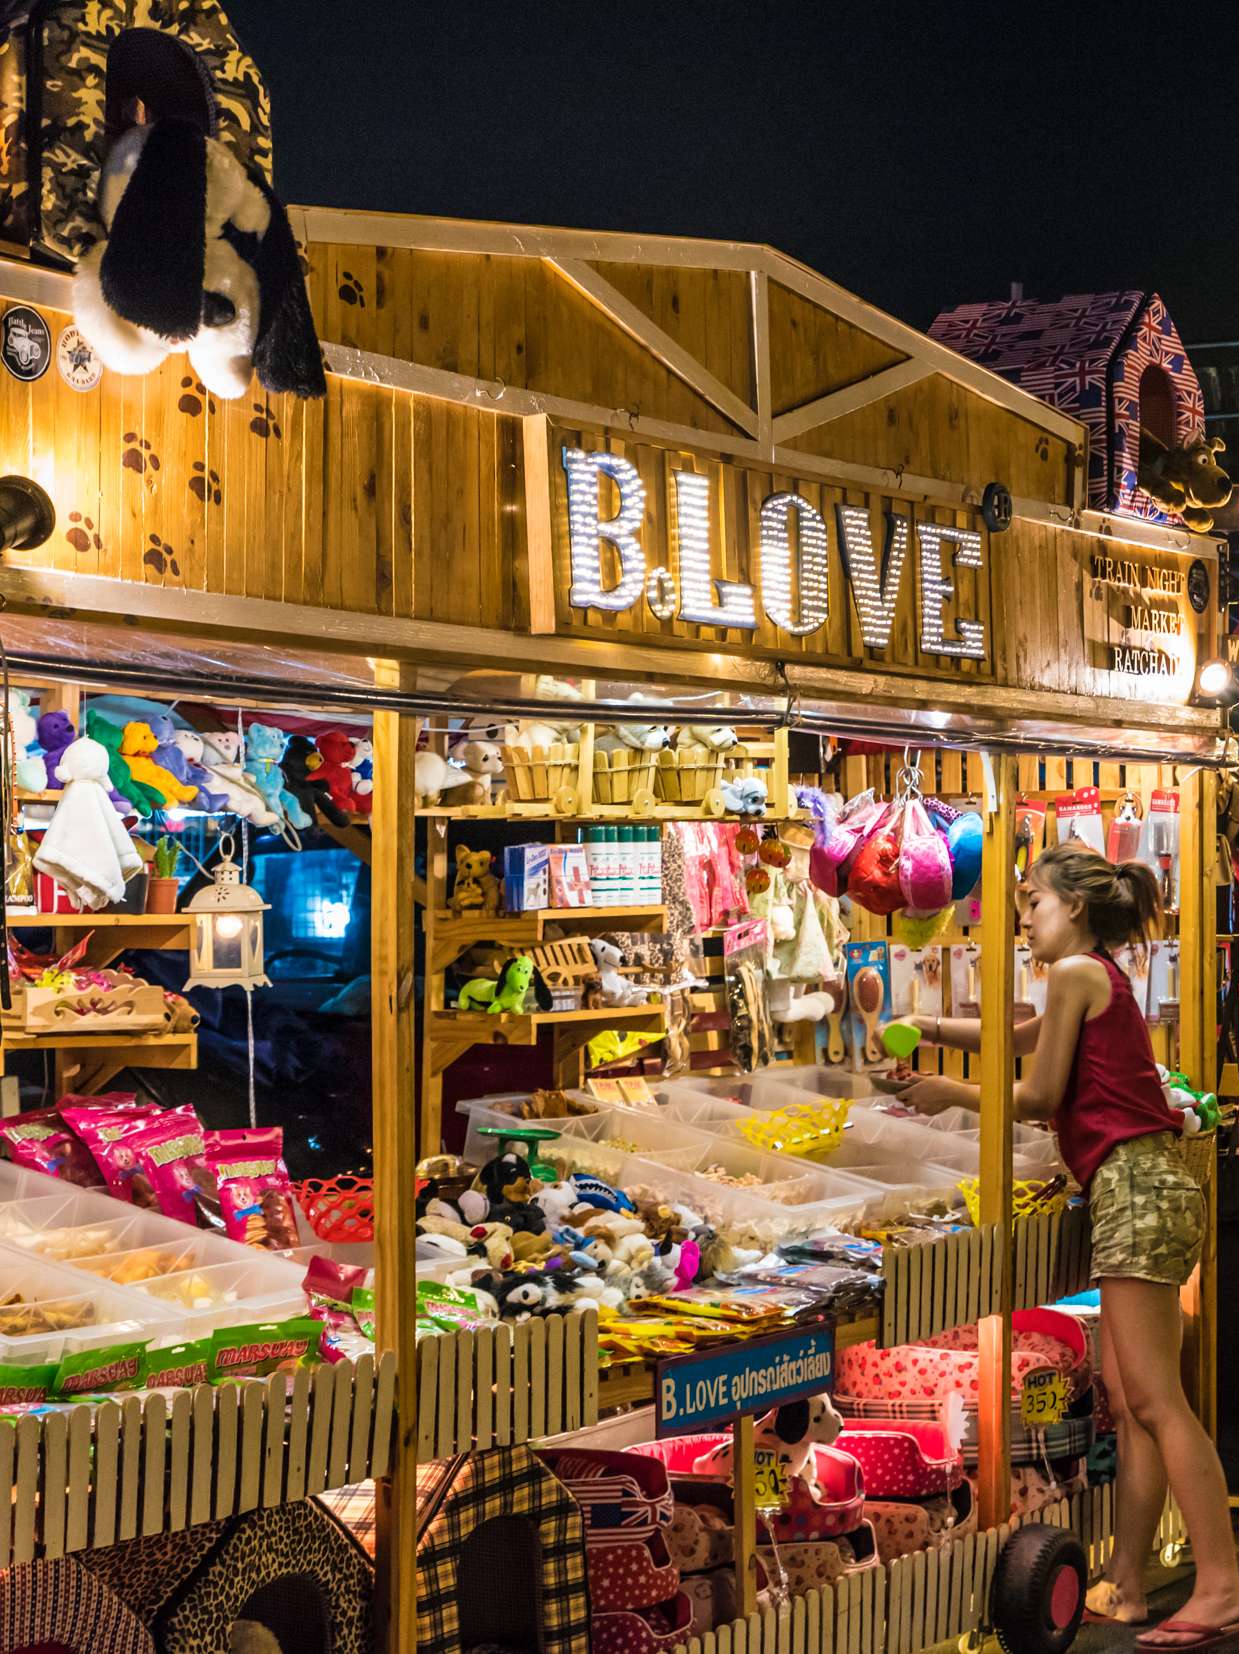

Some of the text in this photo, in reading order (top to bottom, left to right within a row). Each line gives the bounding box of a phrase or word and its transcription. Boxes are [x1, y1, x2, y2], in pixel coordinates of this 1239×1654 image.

[1094, 556, 1185, 595] TRAIN NIGHT
[1131, 605, 1185, 635] MARKET
[146, 1363, 208, 1388] ARSUA
[1027, 1372, 1057, 1389] HOT
[661, 1374, 730, 1421] B.LOVE
